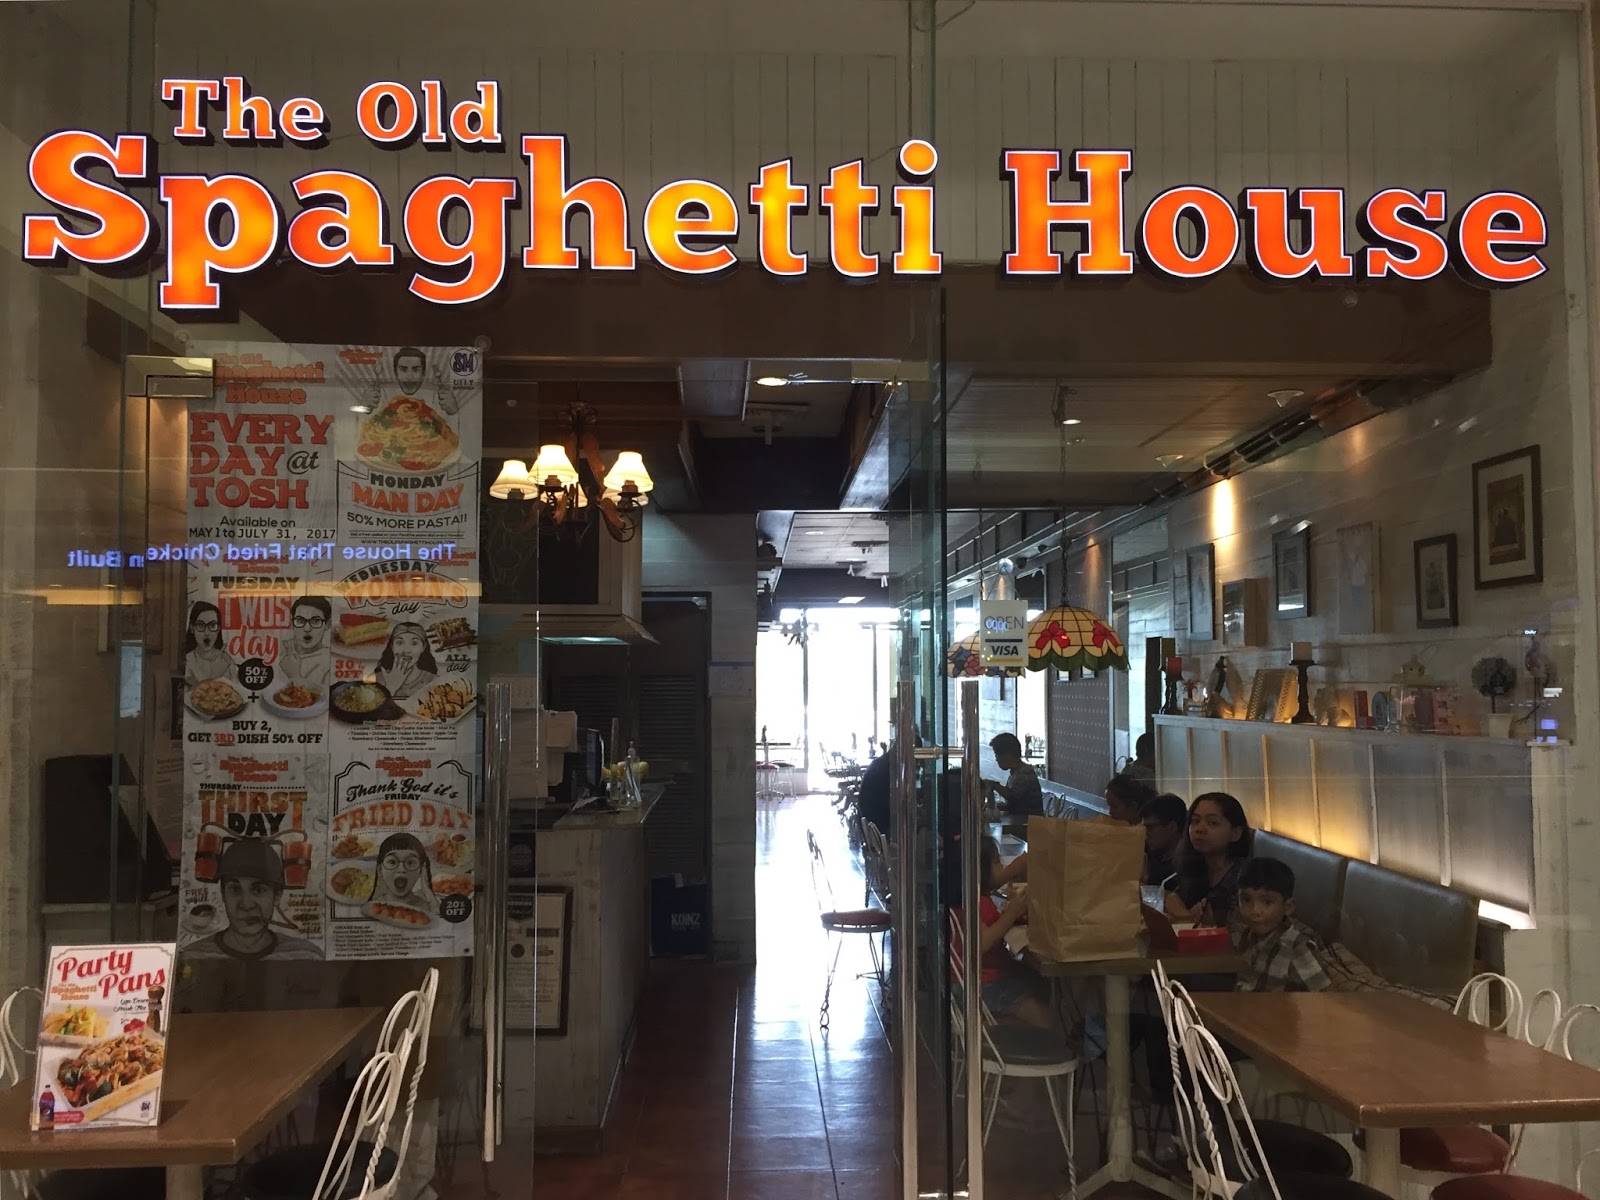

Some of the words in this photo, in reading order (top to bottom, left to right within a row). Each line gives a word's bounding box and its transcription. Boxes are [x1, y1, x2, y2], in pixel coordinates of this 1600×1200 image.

[161, 76, 325, 141] The
[357, 81, 502, 144] Old
[23, 130, 942, 310] Spaghetti
[1004, 149, 1548, 282] House
[213, 360, 326, 387] paghetti
[190, 412, 335, 445] EVERY
[190, 444, 285, 476] DAY
[190, 476, 309, 509] TOSH
[370, 472, 446, 489] MONDAY
[352, 481, 409, 513] MAN
[415, 482, 465, 513] DAY
[220, 515, 278, 528] Available
[281, 519, 296, 528] on
[347, 511, 374, 526] 50%
[376, 517, 415, 529] MORE
[189, 528, 213, 538] MAY
[223, 528, 235, 538] to
[237, 528, 268, 539] JULY
[276, 529, 297, 540] 31,
[307, 529, 336, 539] 2017
[211, 576, 299, 589] TUESDAY
[336, 560, 436, 593] WEDNESDAY
[221, 593, 290, 627] TWOS
[391, 601, 420, 615] day
[228, 625, 279, 666] day
[991, 645, 1019, 656] VISA
[245, 666, 268, 676] 50%
[245, 675, 267, 684] OFF
[446, 663, 470, 673] day
[188, 733, 211, 743] GET
[214, 733, 235, 743] 3RD
[237, 734, 269, 744] DISH
[272, 734, 294, 743] 50%
[297, 734, 323, 743] OFF
[232, 721, 259, 731] BUY
[260, 721, 272, 733] 2,
[346, 779, 398, 802] Thank
[400, 777, 434, 794] God
[385, 793, 421, 801] FRIDAY
[198, 790, 307, 829] THIRST
[332, 801, 413, 833] FRIED
[420, 802, 472, 830] DAY
[228, 812, 286, 837] DAY
[446, 908, 465, 916] OFF
[57, 950, 133, 982] Party
[98, 968, 165, 999] Pans
